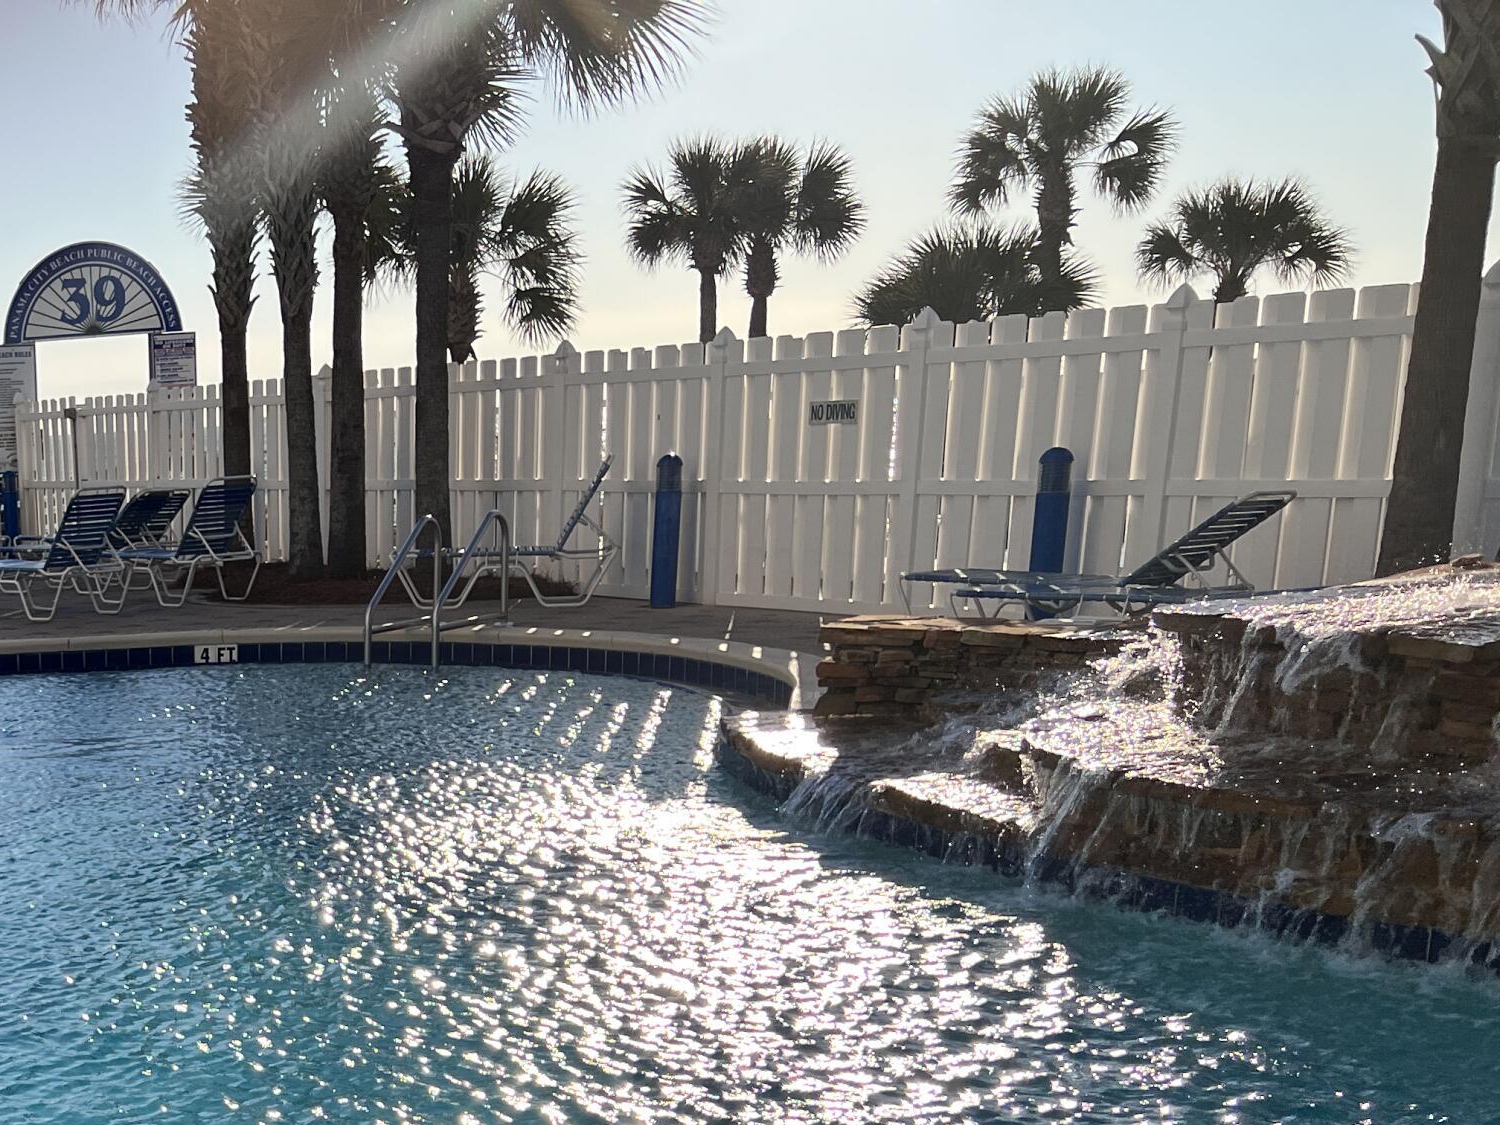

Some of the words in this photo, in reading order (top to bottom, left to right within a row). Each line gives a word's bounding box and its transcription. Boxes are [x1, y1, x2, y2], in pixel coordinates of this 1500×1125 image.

[9, 293, 29, 339] PANAMA
[27, 267, 49, 294] CITY
[49, 250, 85, 270] BEACH
[87, 248, 125, 262] PUBLIC
[125, 256, 156, 287] BEACH
[154, 287, 177, 328] ACCESS
[60, 275, 126, 325] 39
[810, 404, 824, 421] NO
[825, 402, 856, 421] DIVING
[200, 647, 210, 664] 4
